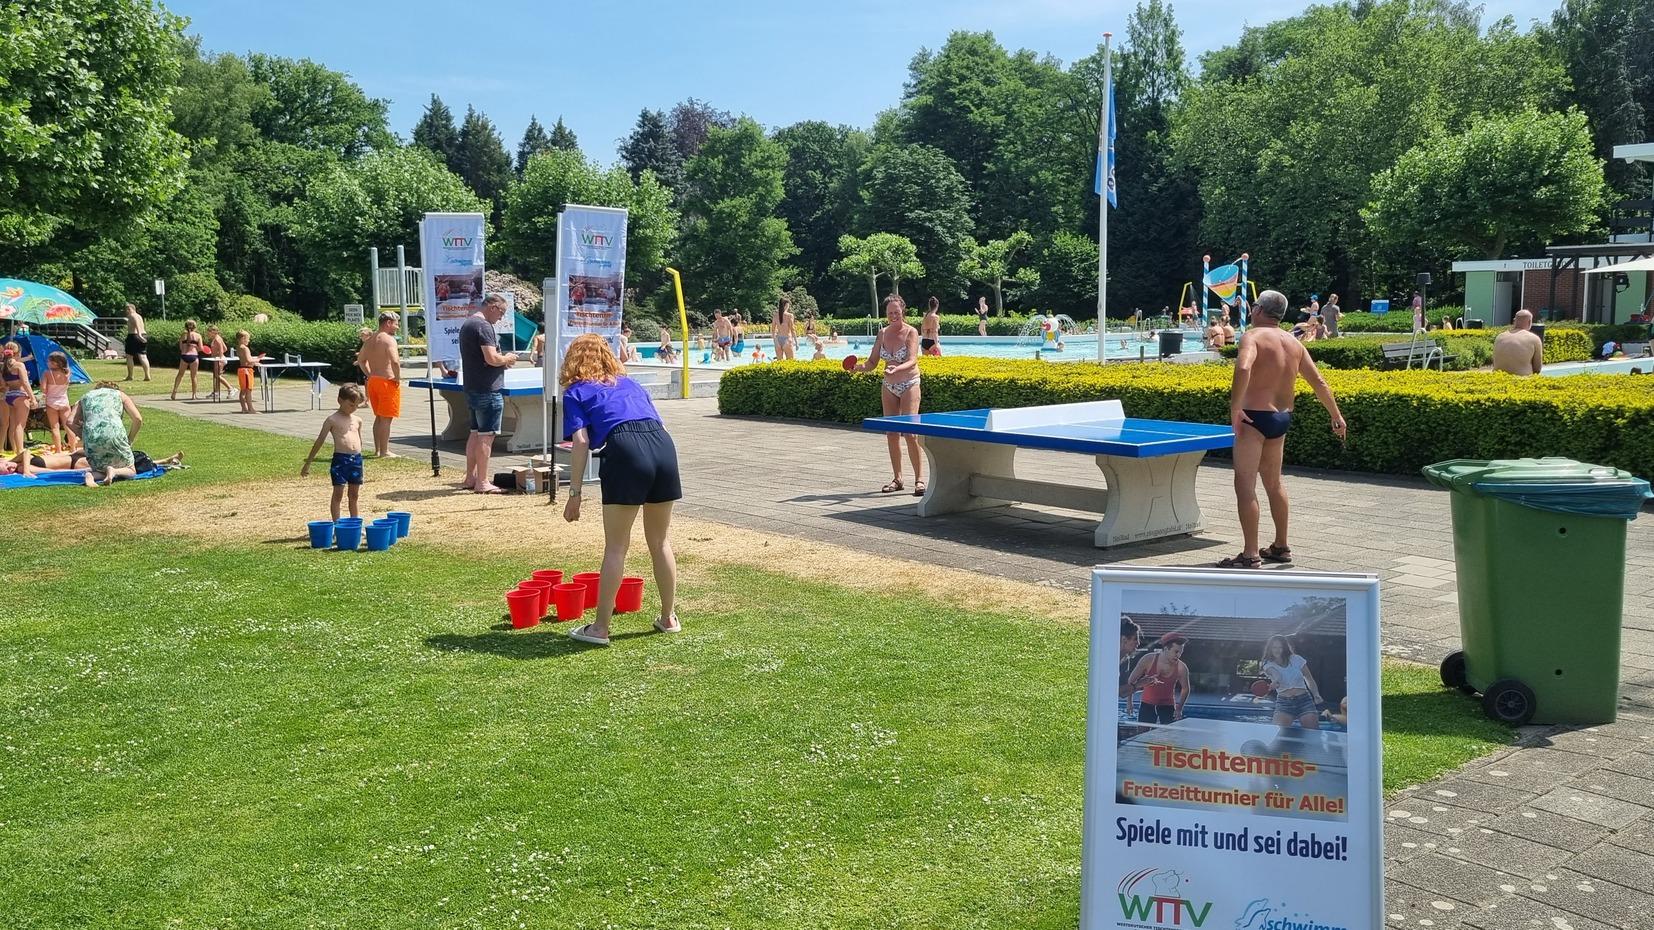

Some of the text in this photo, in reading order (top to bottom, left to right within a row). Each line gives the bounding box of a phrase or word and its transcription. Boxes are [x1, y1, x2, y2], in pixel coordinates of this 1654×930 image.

[442, 237, 473, 247] WTTV
[582, 234, 613, 246] WTTV
[1148, 746, 1316, 777] Tischtennis-
[1122, 780, 1344, 814] Freizeitturnier für Alle!
[1116, 816, 1348, 861] Spiele mit und sei dabei!
[1118, 893, 1214, 928] WTTV
